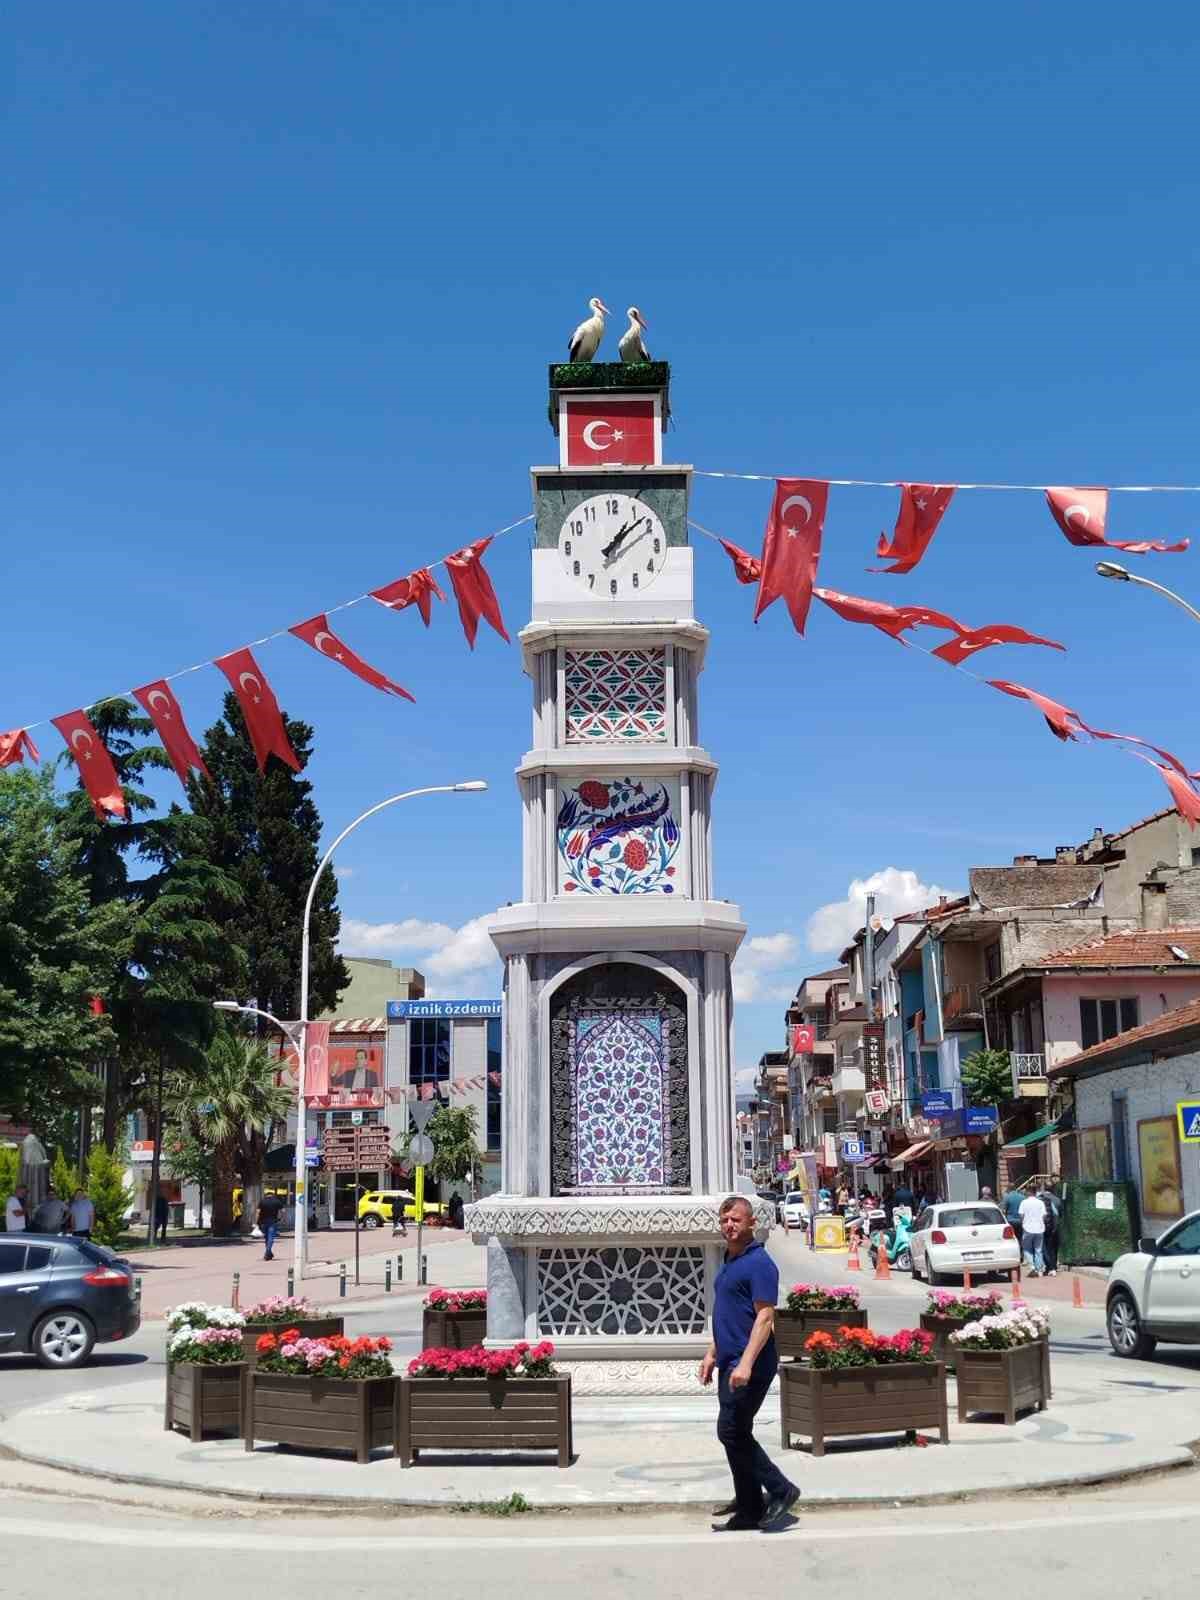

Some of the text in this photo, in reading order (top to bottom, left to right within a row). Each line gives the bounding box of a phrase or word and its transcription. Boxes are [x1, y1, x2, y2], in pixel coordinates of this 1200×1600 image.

[584, 507, 596, 521] 11
[606, 500, 618, 515] 12
[570, 521, 583, 536] 10
[646, 519, 653, 534] 2
[565, 541, 571, 555] 9
[654, 538, 660, 554] 3
[574, 561, 580, 576] 8
[647, 558, 654, 573] 4
[588, 574, 595, 589] 7
[610, 579, 617, 595] 6
[633, 573, 639, 588] 5
[409, 1003, 442, 1014] iznik
